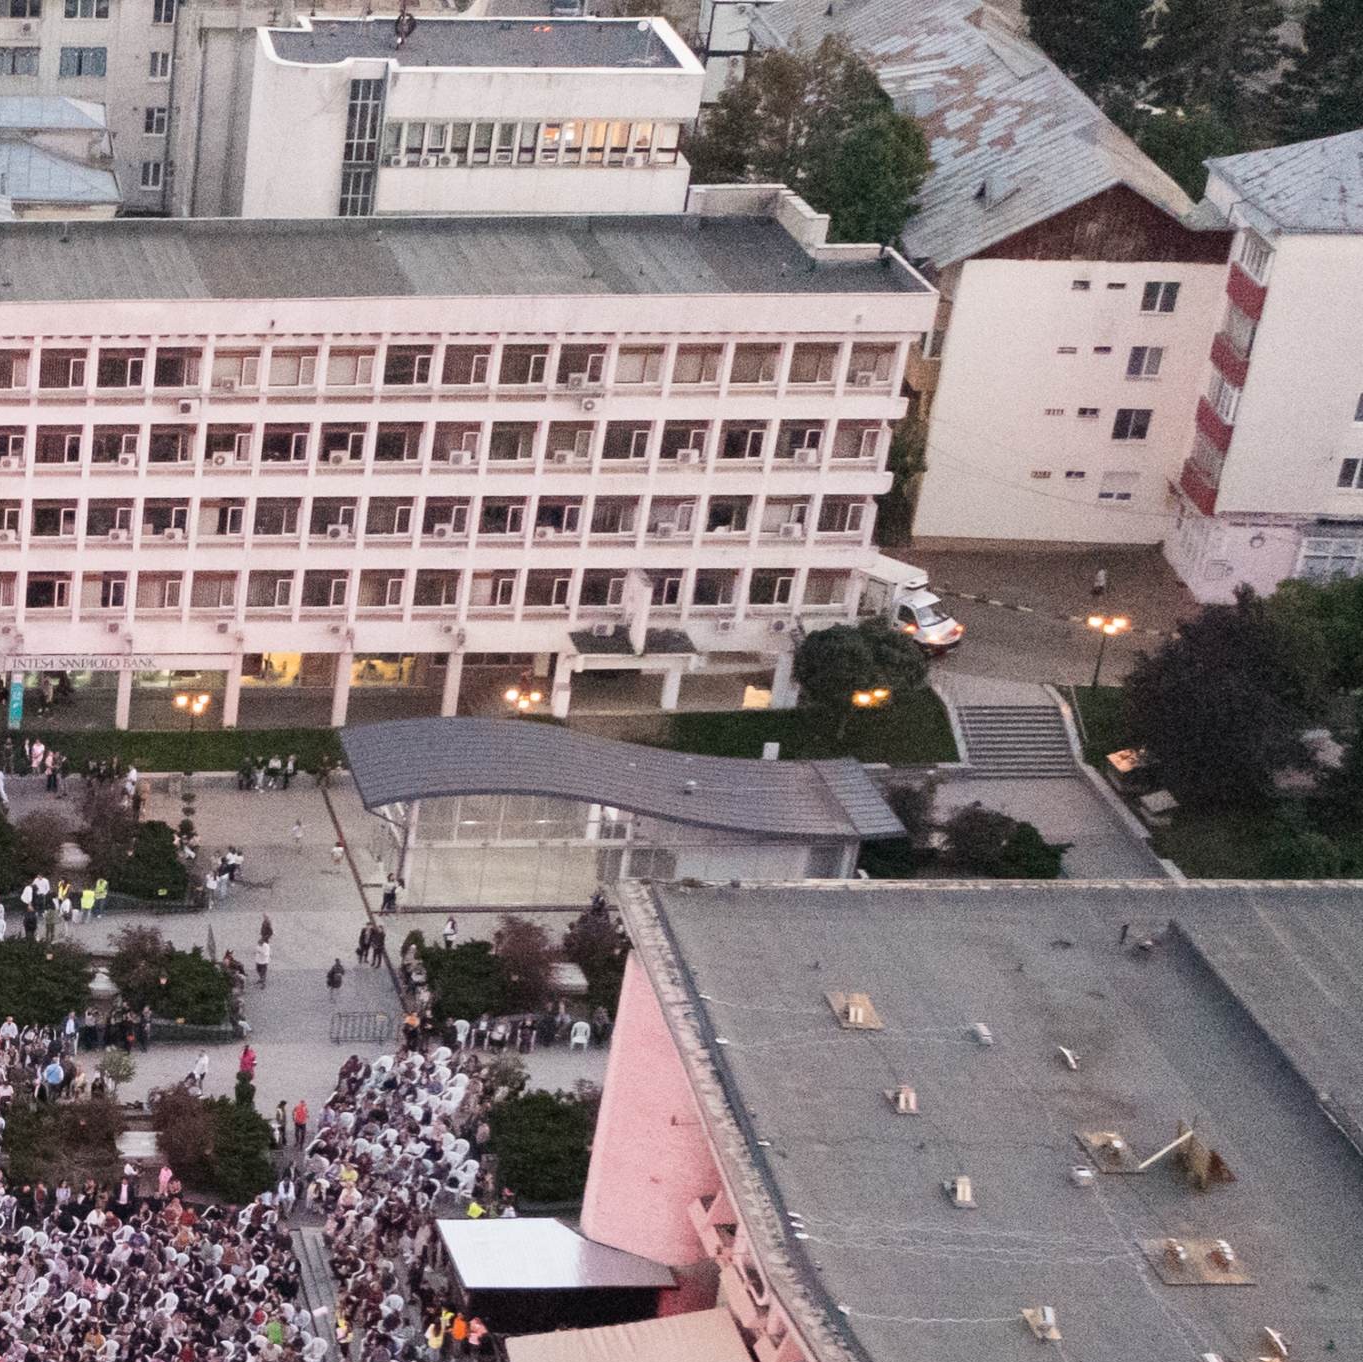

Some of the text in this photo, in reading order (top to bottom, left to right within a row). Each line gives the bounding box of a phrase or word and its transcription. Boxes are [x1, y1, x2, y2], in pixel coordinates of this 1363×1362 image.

[13, 657, 157, 669] INTESA SANPAOLO BANK
